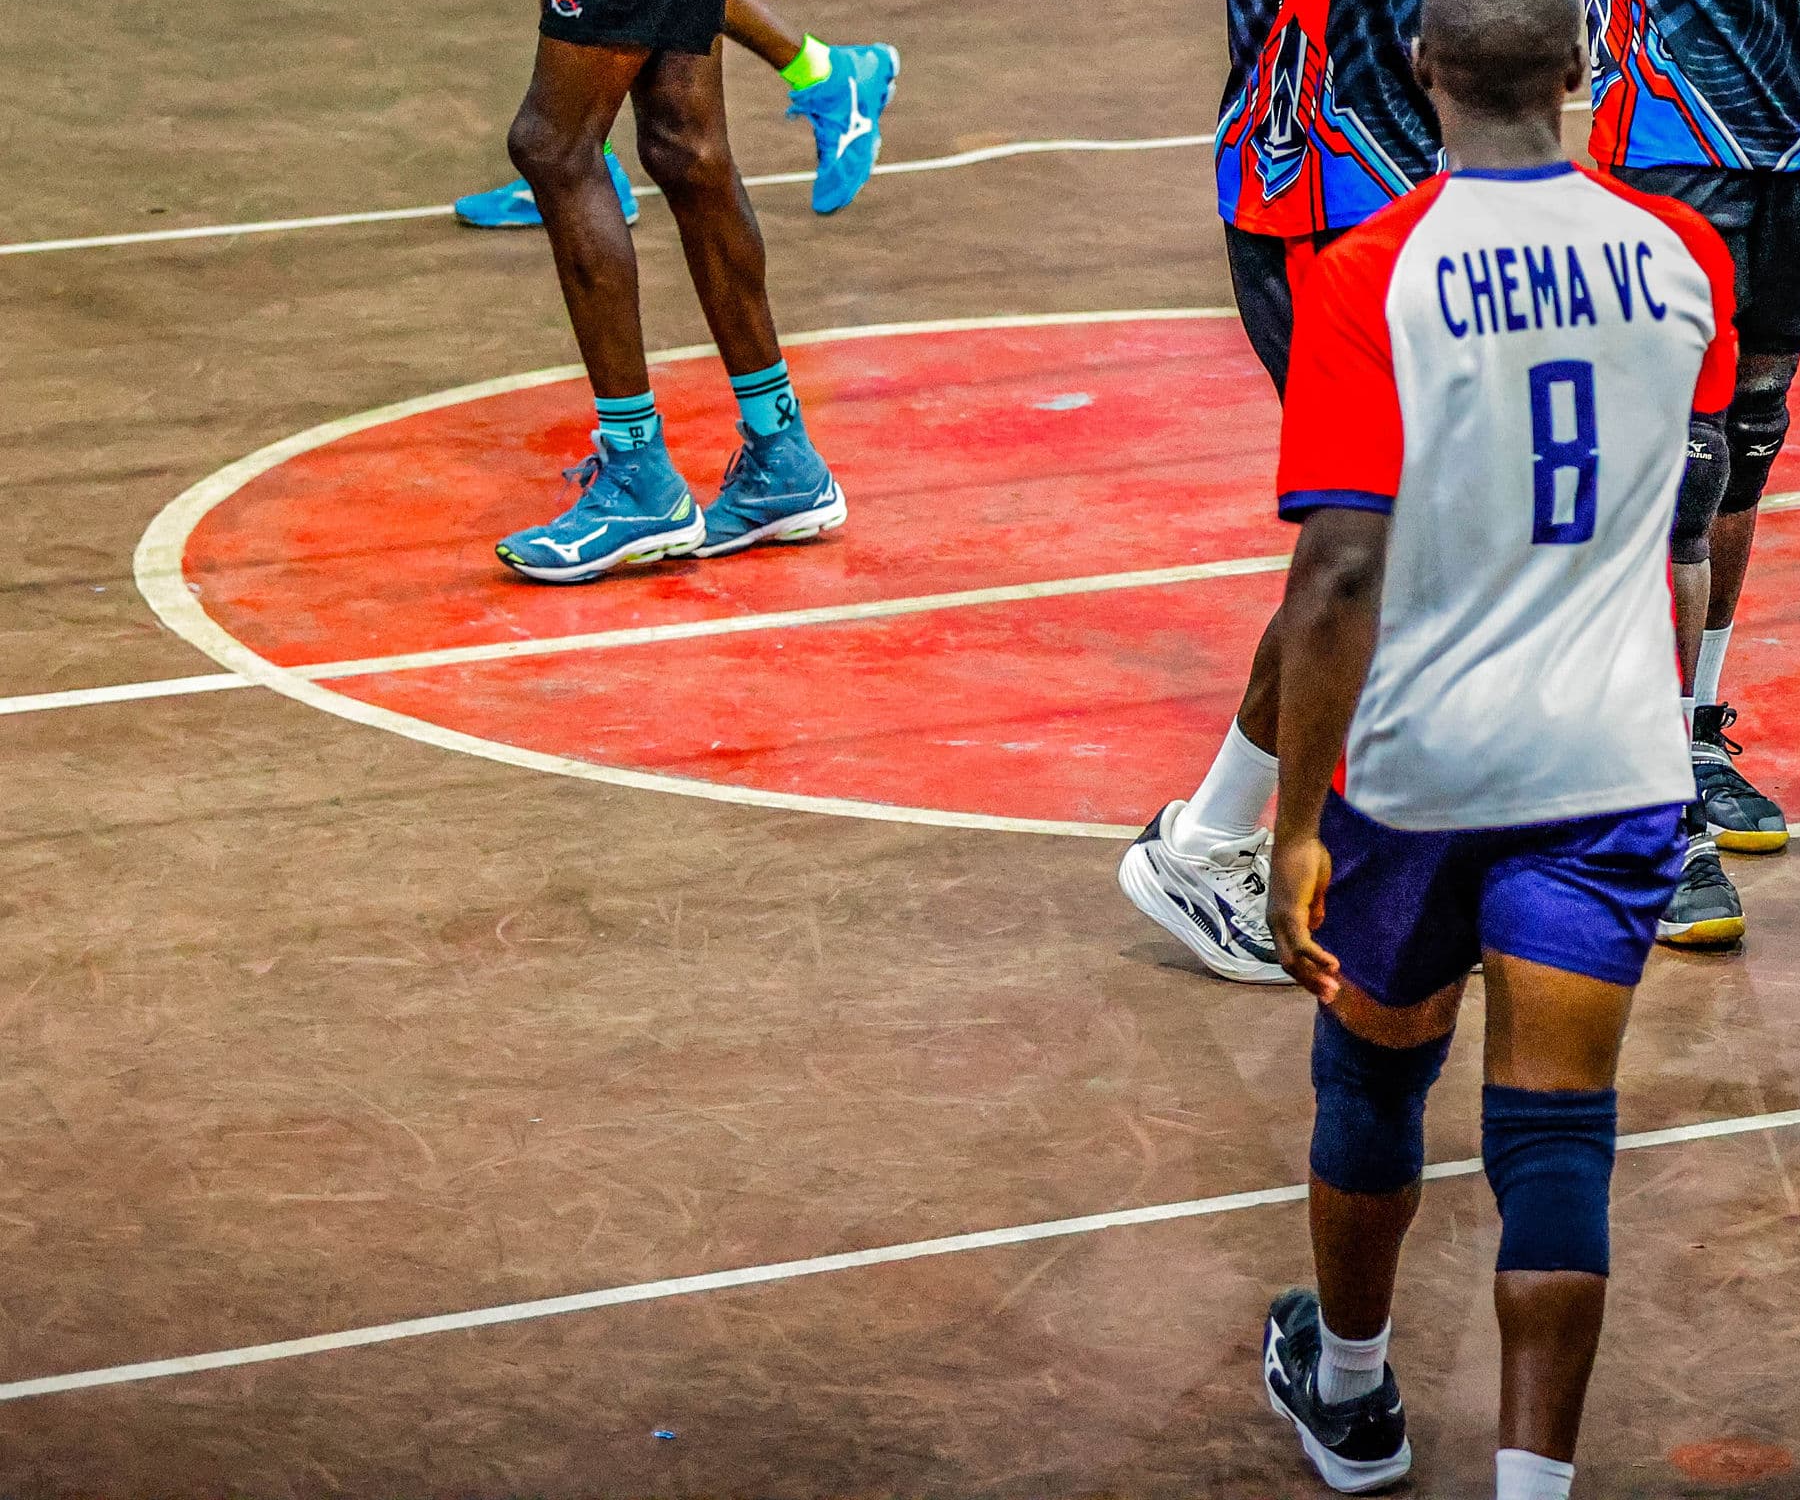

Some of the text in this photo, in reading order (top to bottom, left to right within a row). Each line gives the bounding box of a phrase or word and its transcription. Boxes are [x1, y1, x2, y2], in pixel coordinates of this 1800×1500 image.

[1436, 241, 1667, 339] CHEMA VC
[1528, 360, 1601, 545] 8
